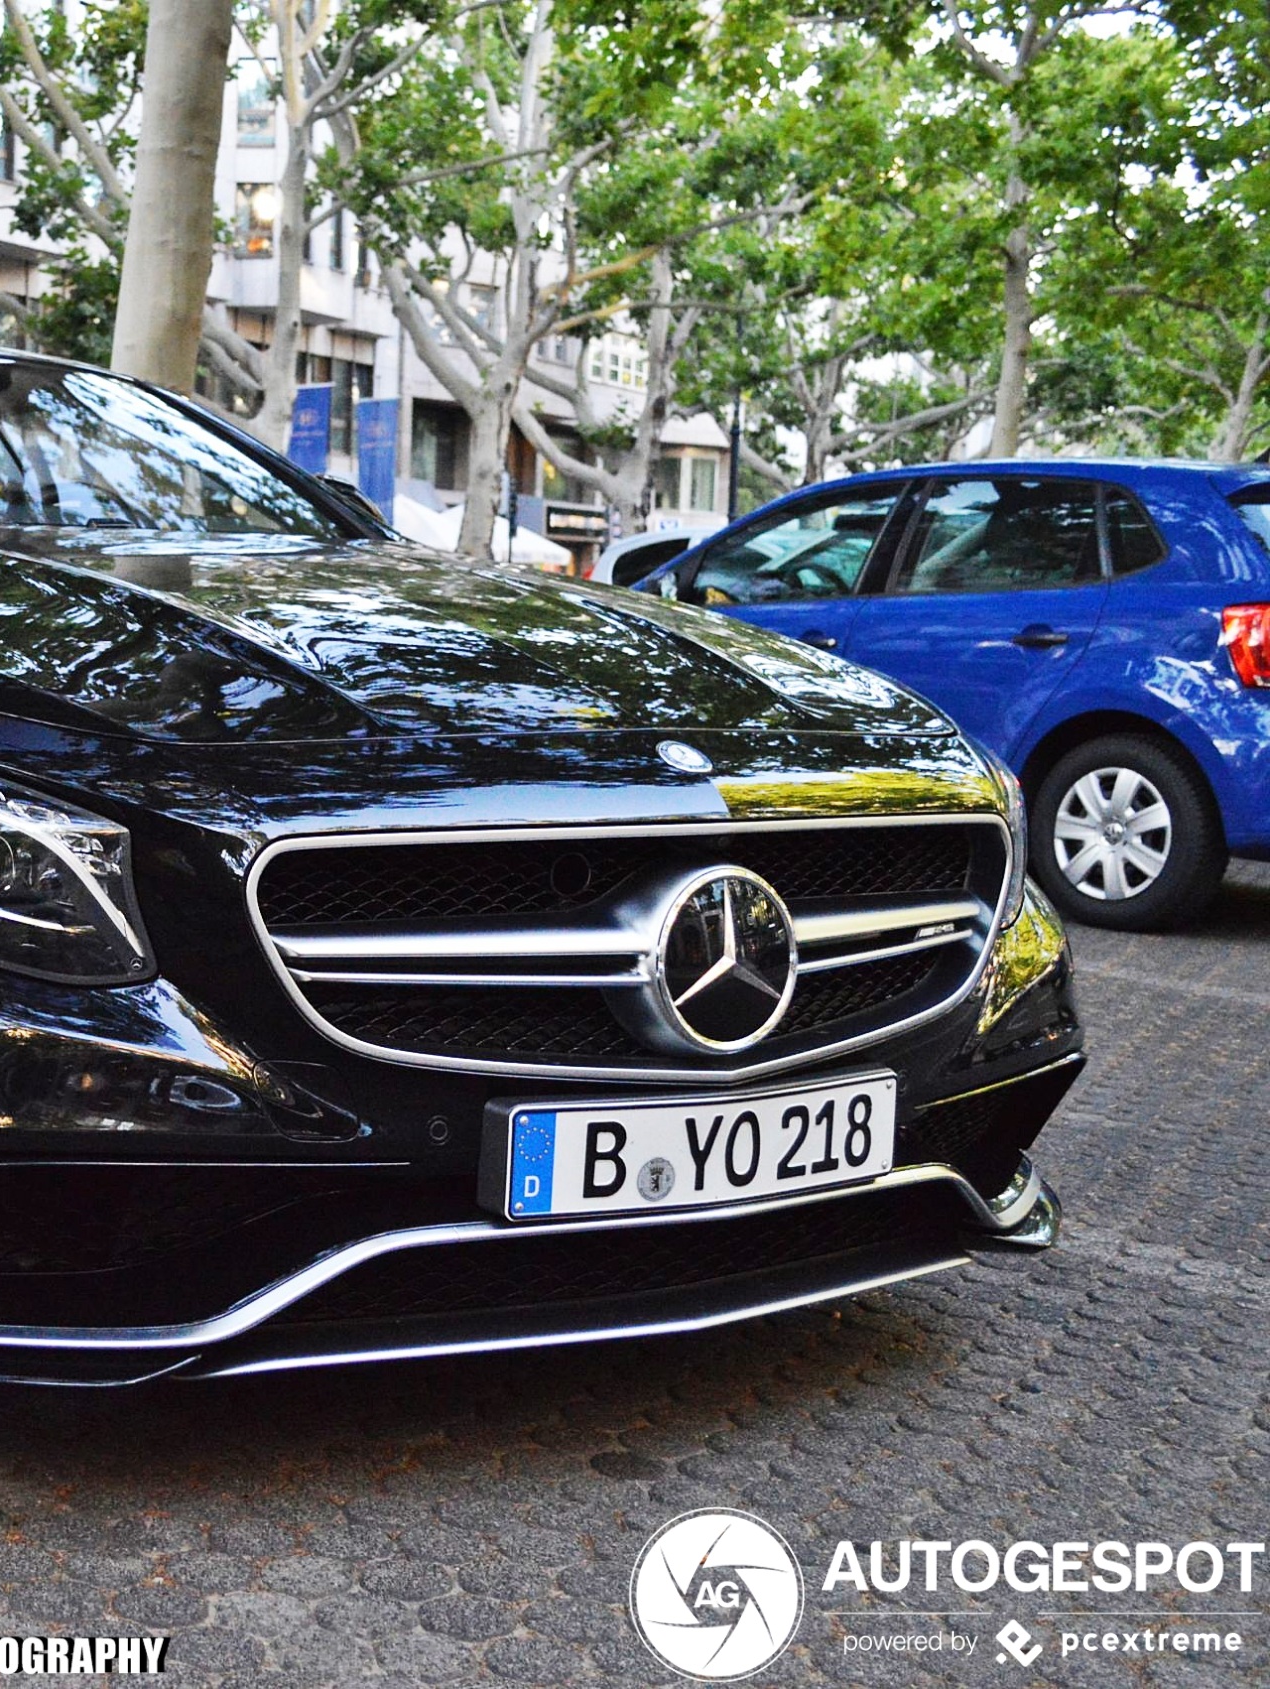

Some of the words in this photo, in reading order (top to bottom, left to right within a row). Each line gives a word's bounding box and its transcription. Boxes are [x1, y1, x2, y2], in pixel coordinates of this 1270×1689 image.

[582, 1121, 627, 1199] B
[685, 1110, 761, 1191] YO
[776, 1093, 873, 1180] 218
[523, 1174, 539, 1198] D
